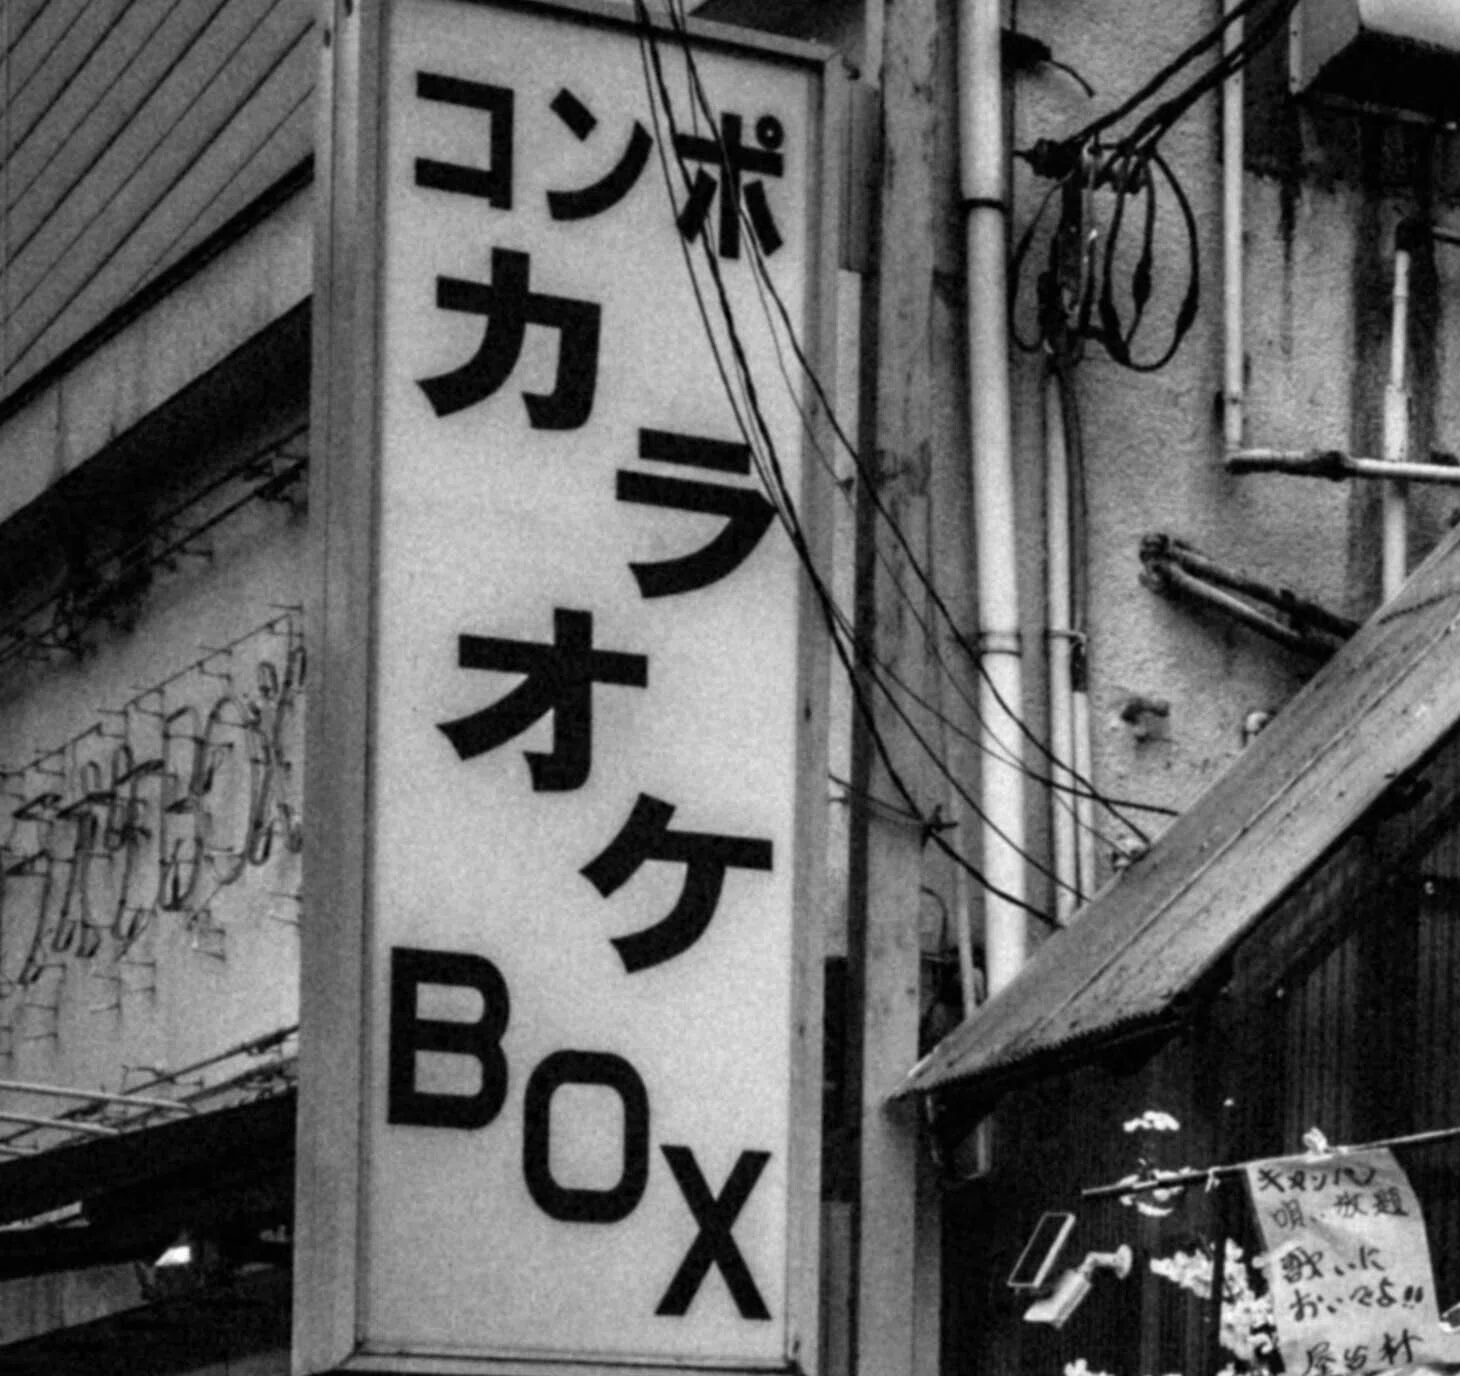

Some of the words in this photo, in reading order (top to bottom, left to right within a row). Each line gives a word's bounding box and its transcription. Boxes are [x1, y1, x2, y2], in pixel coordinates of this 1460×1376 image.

[414, 70, 784, 260] コンポ
[387, 945, 772, 1322] BOX
